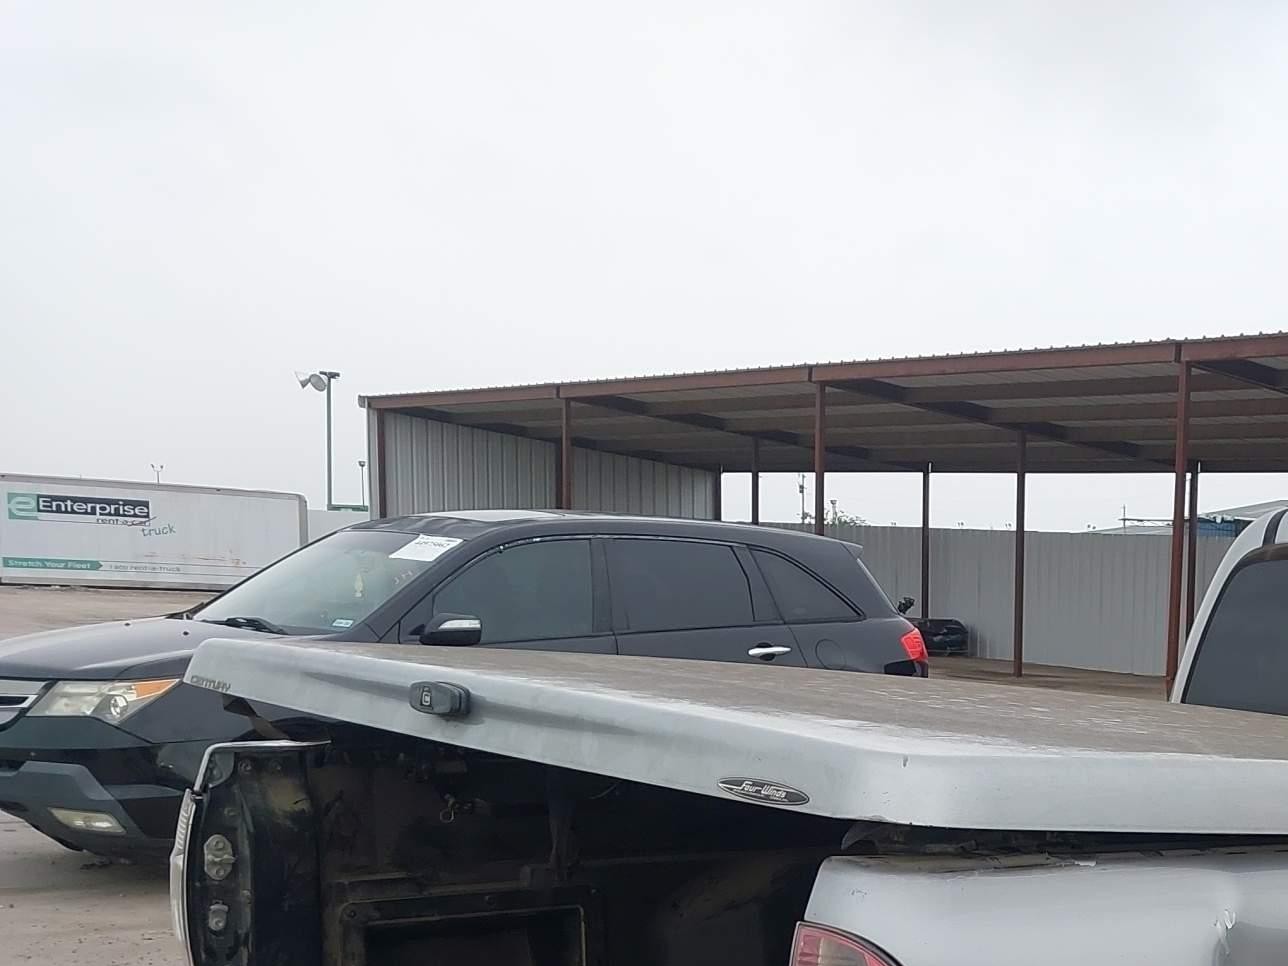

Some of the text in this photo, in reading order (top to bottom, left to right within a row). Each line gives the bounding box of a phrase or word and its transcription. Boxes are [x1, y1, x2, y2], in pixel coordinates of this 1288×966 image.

[38, 497, 149, 517] Enterprise
[141, 524, 176, 537] truck
[45, 560, 66, 569] Your
[67, 561, 91, 570] Fleet
[761, 784, 787, 798] Winds
